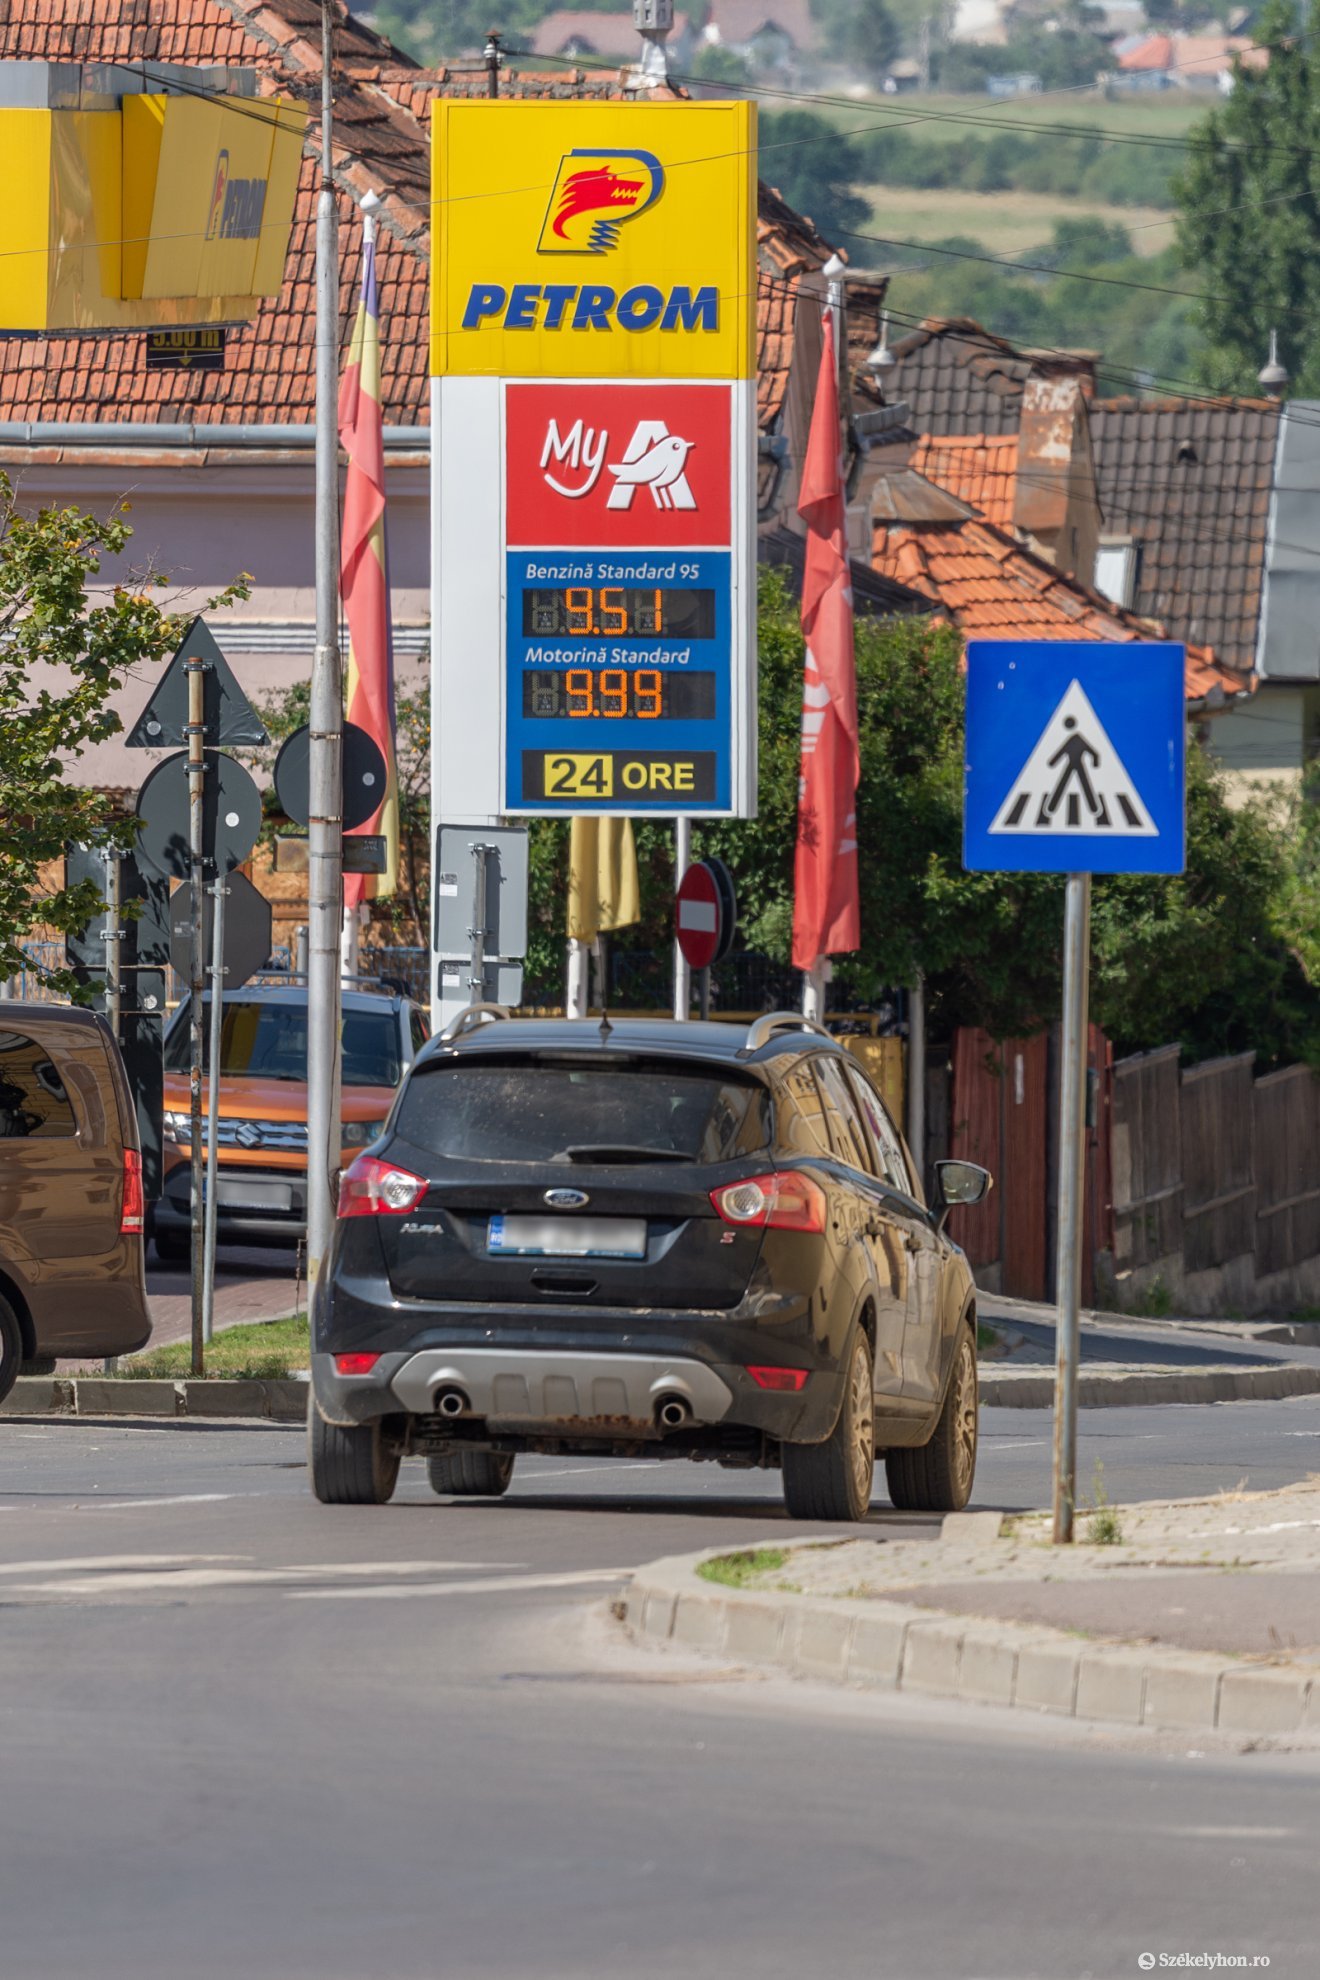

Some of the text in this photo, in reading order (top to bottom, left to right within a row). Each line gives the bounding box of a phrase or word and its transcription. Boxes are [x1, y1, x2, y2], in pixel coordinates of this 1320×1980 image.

[461, 284, 719, 331] PETROM
[539, 418, 608, 498] My
[525, 563, 700, 580] Benzină Standard 95
[565, 587, 662, 635] 9.51
[525, 647, 690, 664] Motorină Standard
[565, 669, 662, 718] 9.99
[551, 758, 695, 793] 24 ORE
